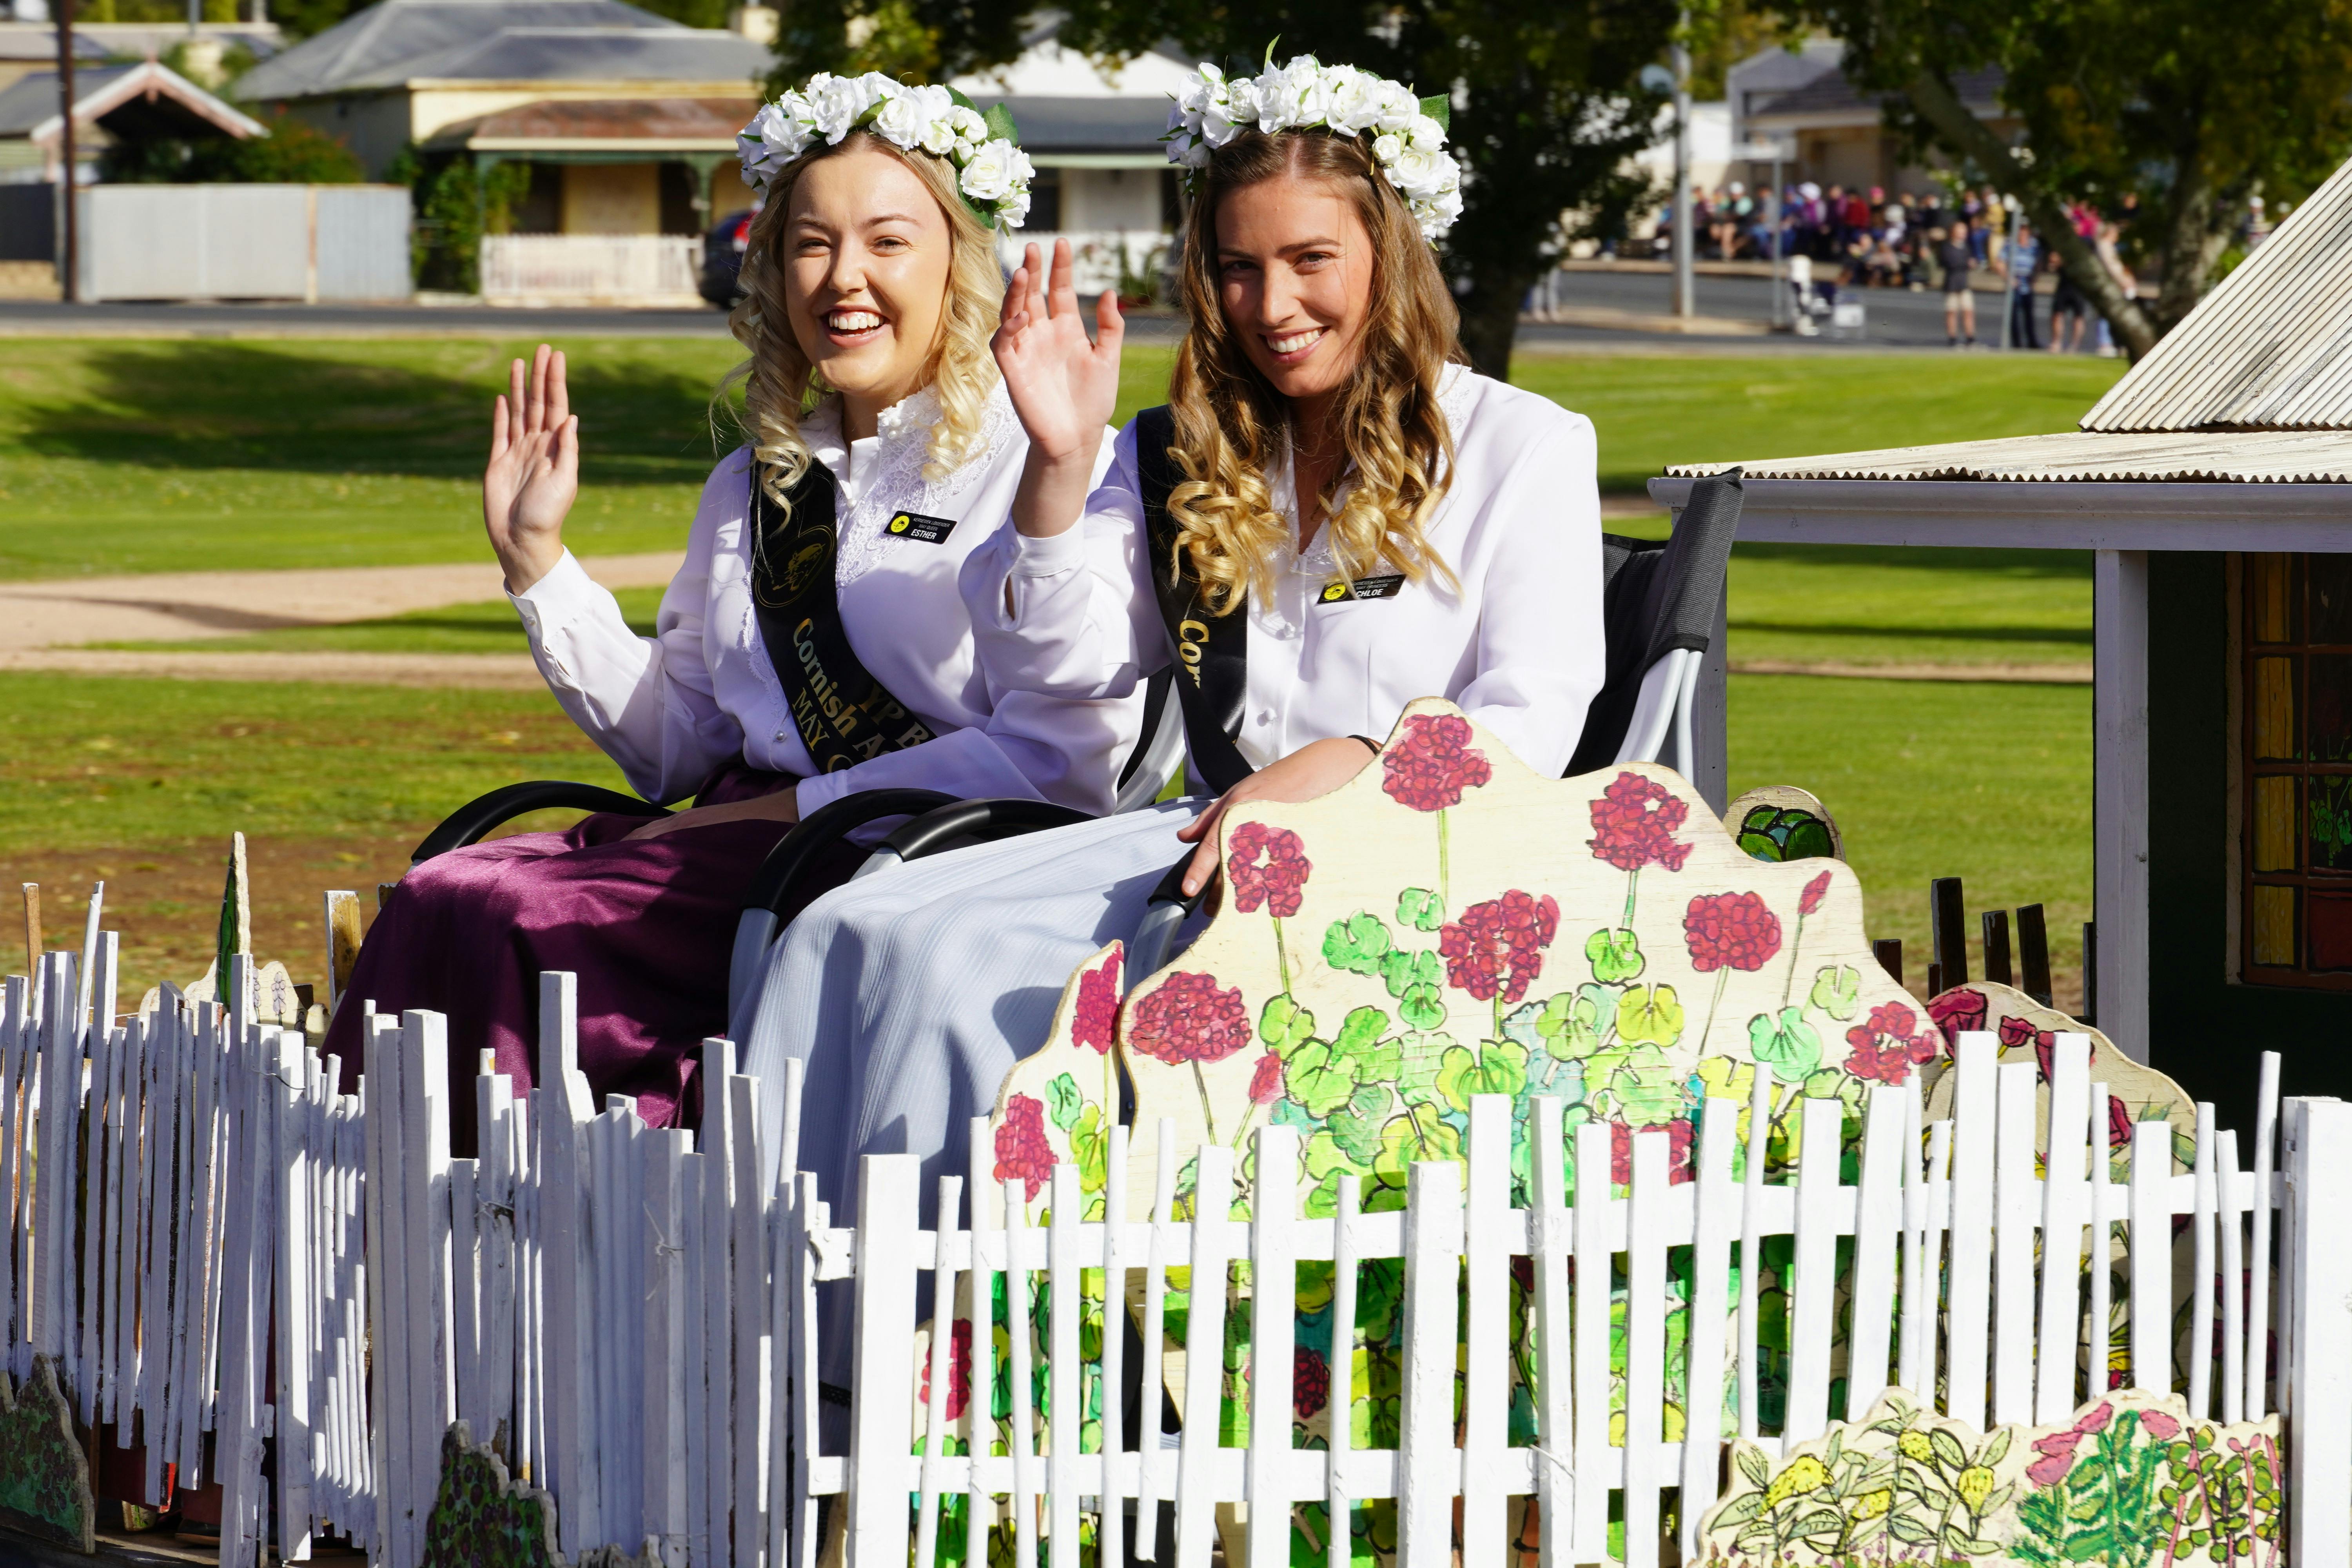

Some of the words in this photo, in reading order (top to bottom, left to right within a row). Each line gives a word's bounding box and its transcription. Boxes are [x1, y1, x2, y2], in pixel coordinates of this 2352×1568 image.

[911, 529, 937, 539] ESTHER
[1356, 588, 1384, 597] CHLOE
[793, 618, 858, 738] Cornish
[792, 687, 830, 752] MAY
